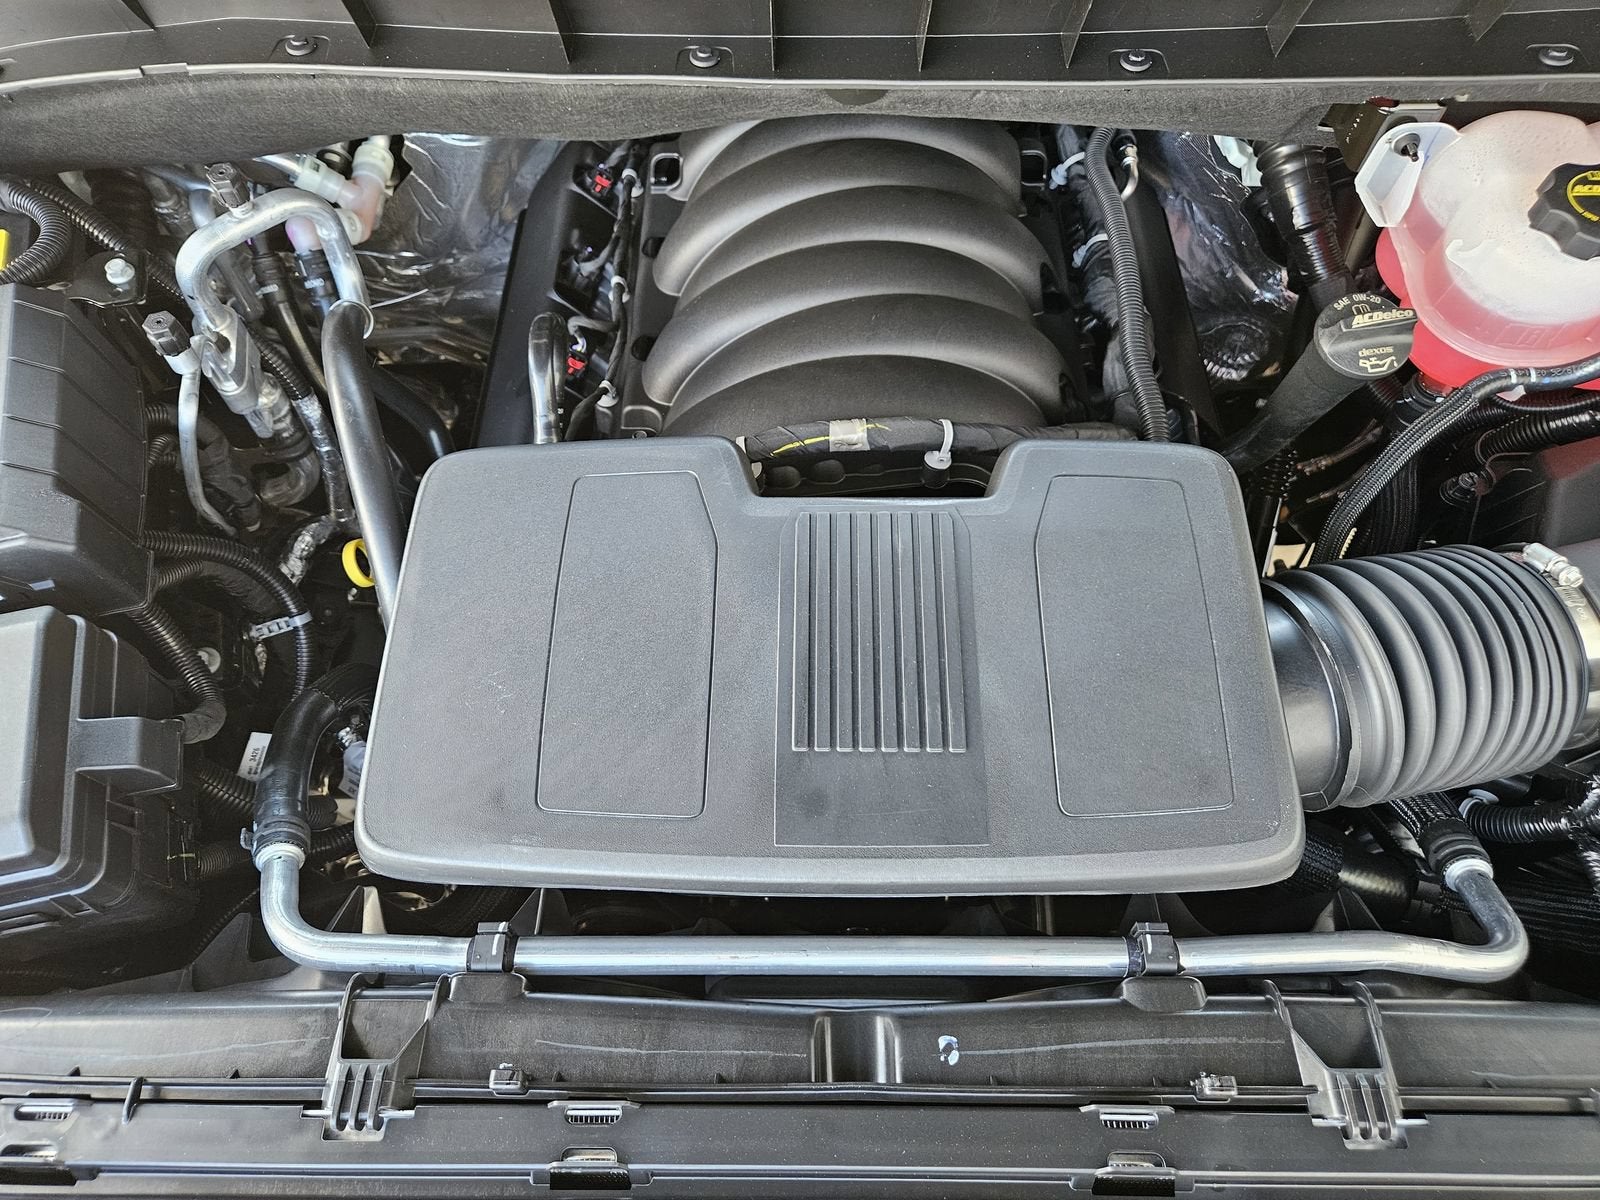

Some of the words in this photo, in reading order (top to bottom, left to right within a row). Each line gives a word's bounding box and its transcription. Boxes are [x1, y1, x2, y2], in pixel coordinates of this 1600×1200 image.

[1333, 296, 1351, 311] SAE
[1352, 293, 1382, 304] 0W-20
[1352, 309, 1414, 325] ACDelco
[1358, 346, 1394, 357] dexos
